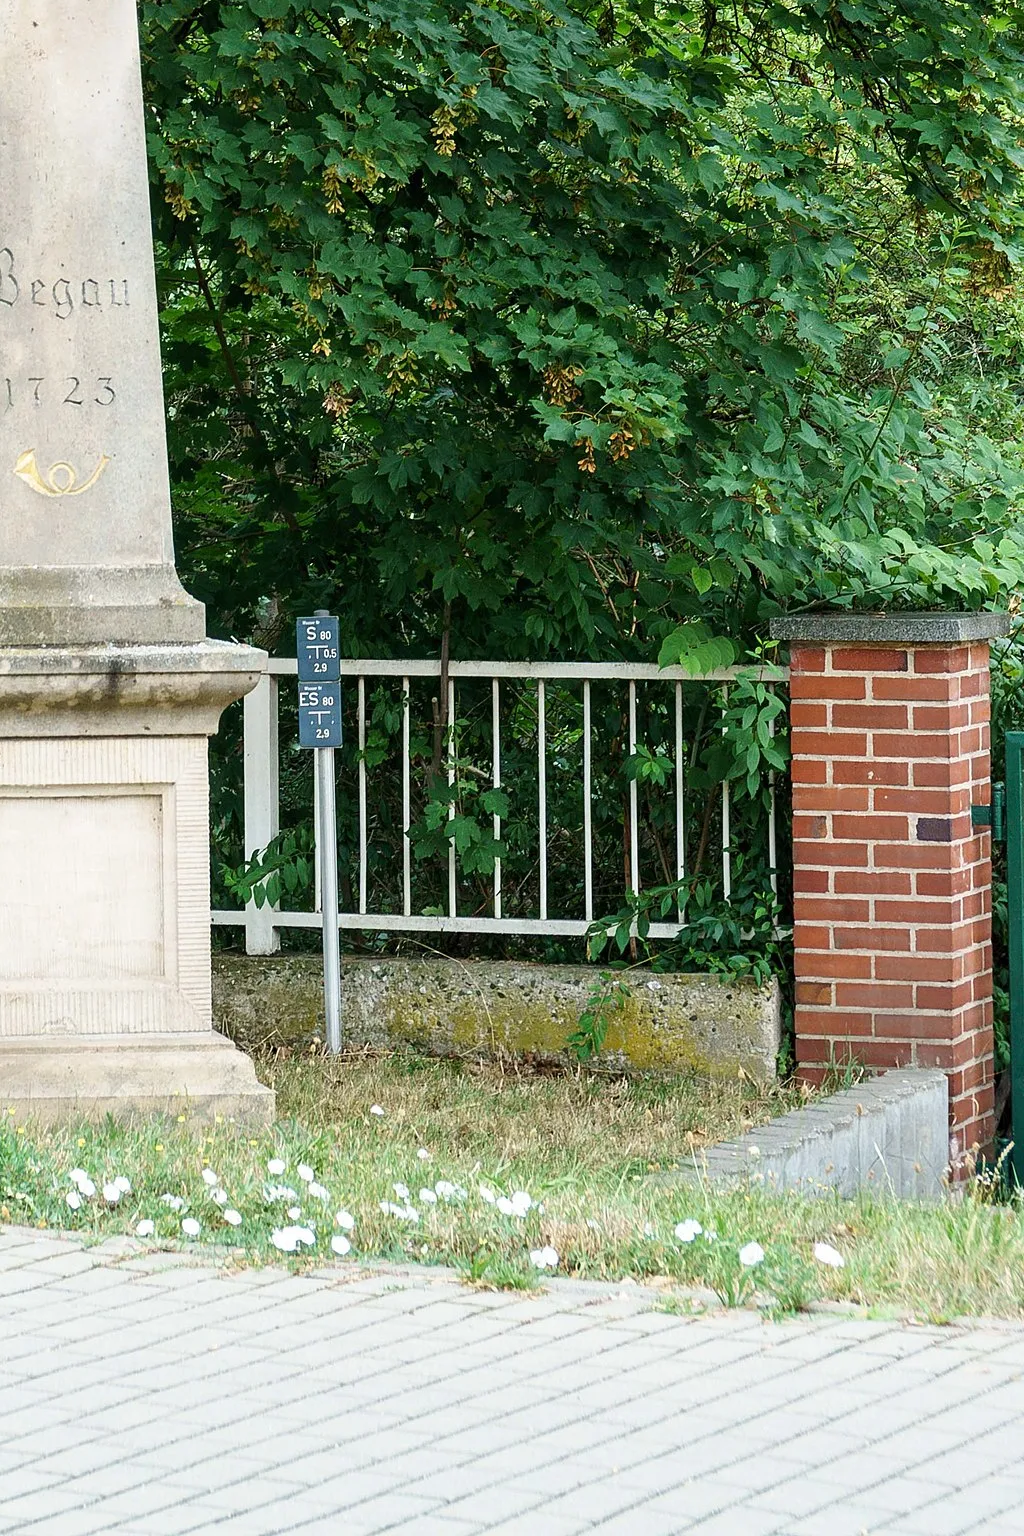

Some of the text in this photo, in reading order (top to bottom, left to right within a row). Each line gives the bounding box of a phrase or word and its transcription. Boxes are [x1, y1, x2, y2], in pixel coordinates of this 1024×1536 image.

[4, 376, 116, 416] 1723
[306, 626, 332, 641] S 80
[299, 692, 334, 707] ES 80
